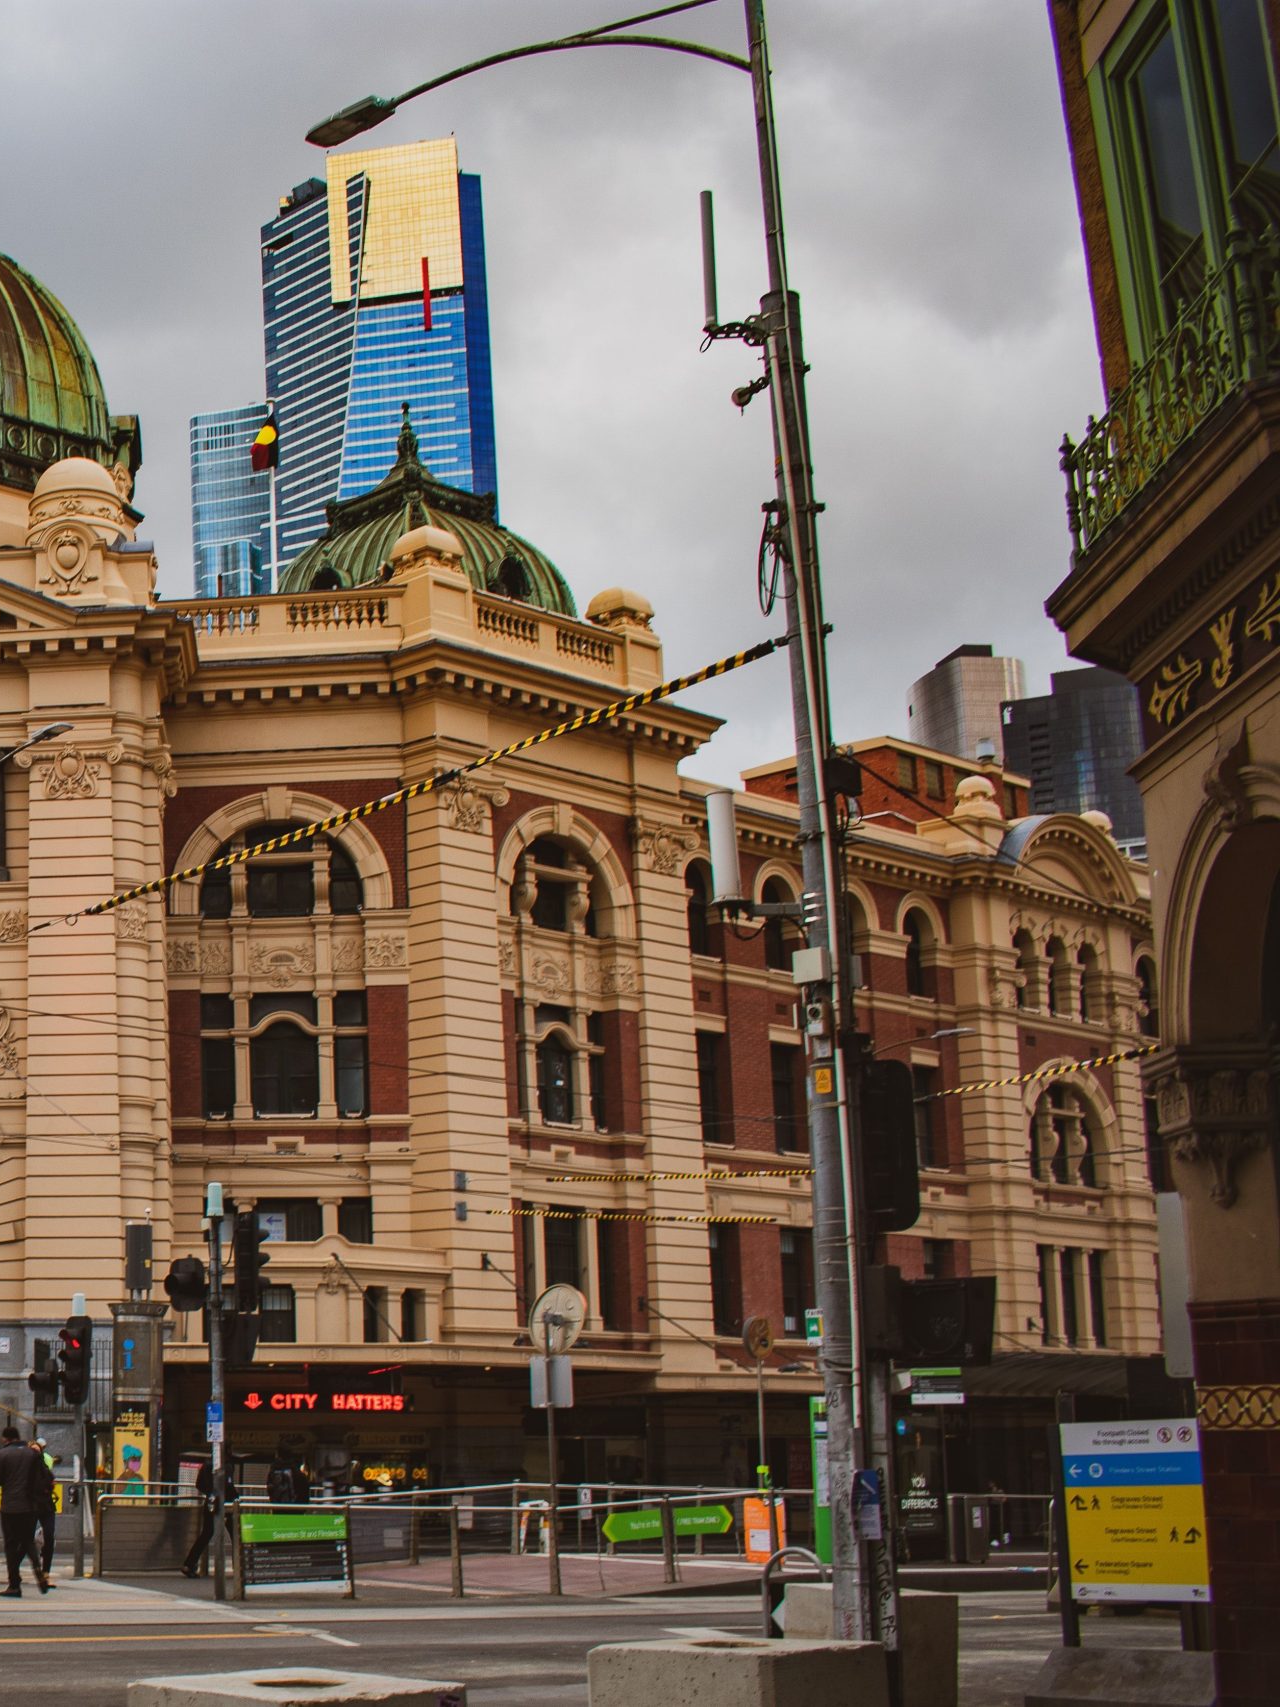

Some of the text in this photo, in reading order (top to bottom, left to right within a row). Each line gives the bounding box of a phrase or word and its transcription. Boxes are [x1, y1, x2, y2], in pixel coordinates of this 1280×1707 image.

[270, 1393, 404, 1411] CITY HATTERS
[1096, 1429, 1149, 1438] Footpath Closed
[1102, 1438, 1125, 1447] through
[1109, 1465, 1135, 1473] Flinders
[1136, 1465, 1157, 1473] Street
[911, 1476, 926, 1488] YOU
[901, 1498, 938, 1510] DIFFERENCE
[1095, 1560, 1153, 1569] Federation Square
